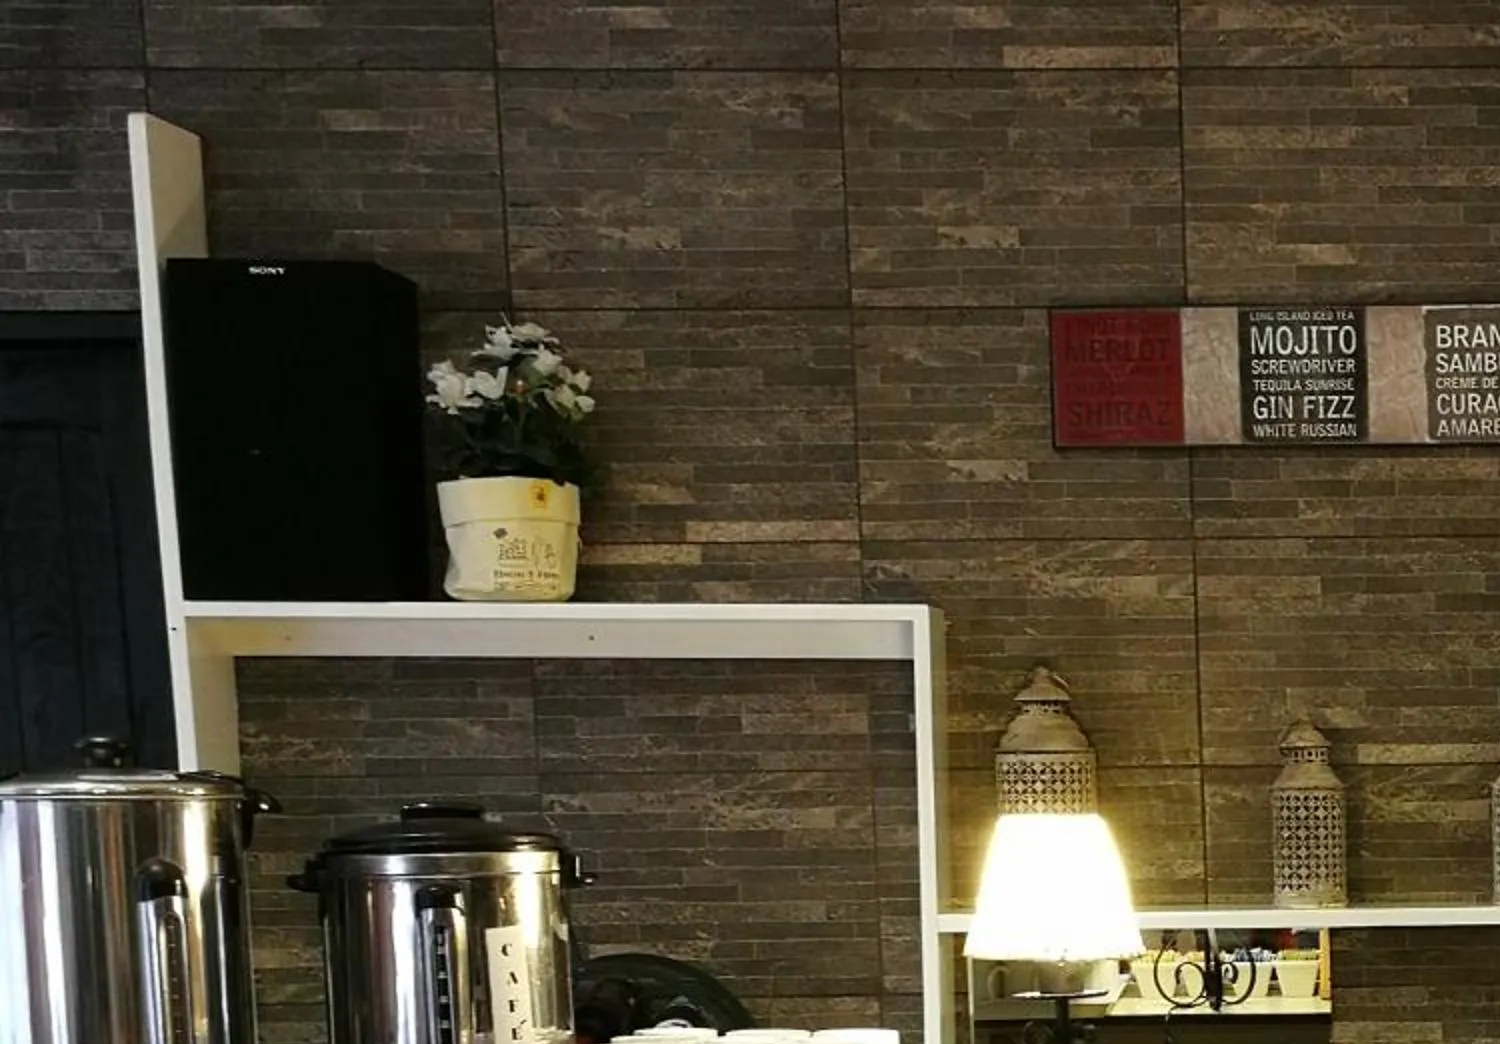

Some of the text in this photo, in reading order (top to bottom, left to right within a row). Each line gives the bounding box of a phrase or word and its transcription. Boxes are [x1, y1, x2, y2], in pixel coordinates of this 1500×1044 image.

[1249, 324, 1357, 355] MOJITO
[1250, 359, 1356, 375] SCREWDRIVER
[1252, 378, 1355, 392] TEQUILA SUNRISE
[1483, 377, 1499, 389] DE
[1253, 395, 1355, 420] GIN FIZZ
[1253, 424, 1356, 438] WHITE RUSSIAN
